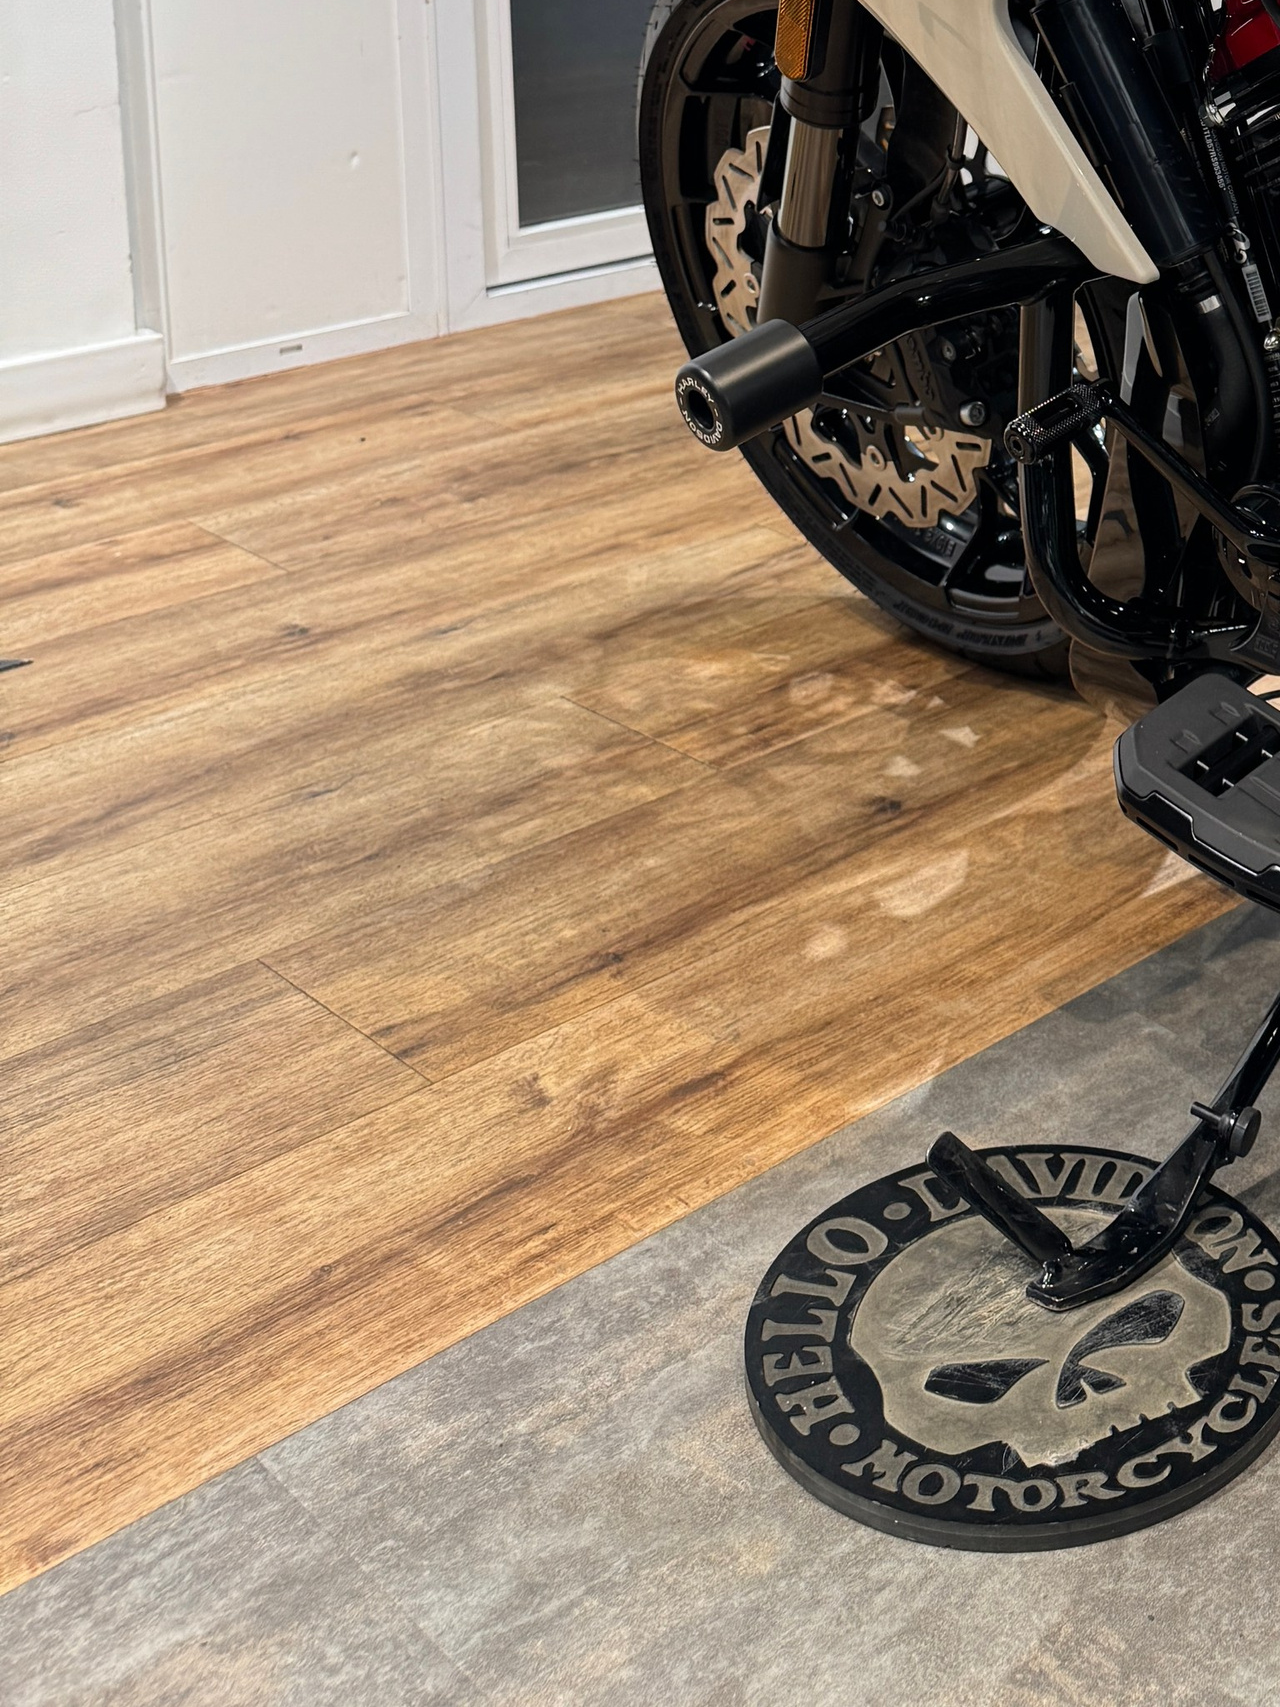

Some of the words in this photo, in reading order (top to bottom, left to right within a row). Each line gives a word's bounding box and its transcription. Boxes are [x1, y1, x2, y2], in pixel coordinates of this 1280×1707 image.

[677, 377, 714, 403] HARLEY
[682, 409, 723, 444] DAVIDSON
[897, 1152, 1279, 1274] DAVIDON
